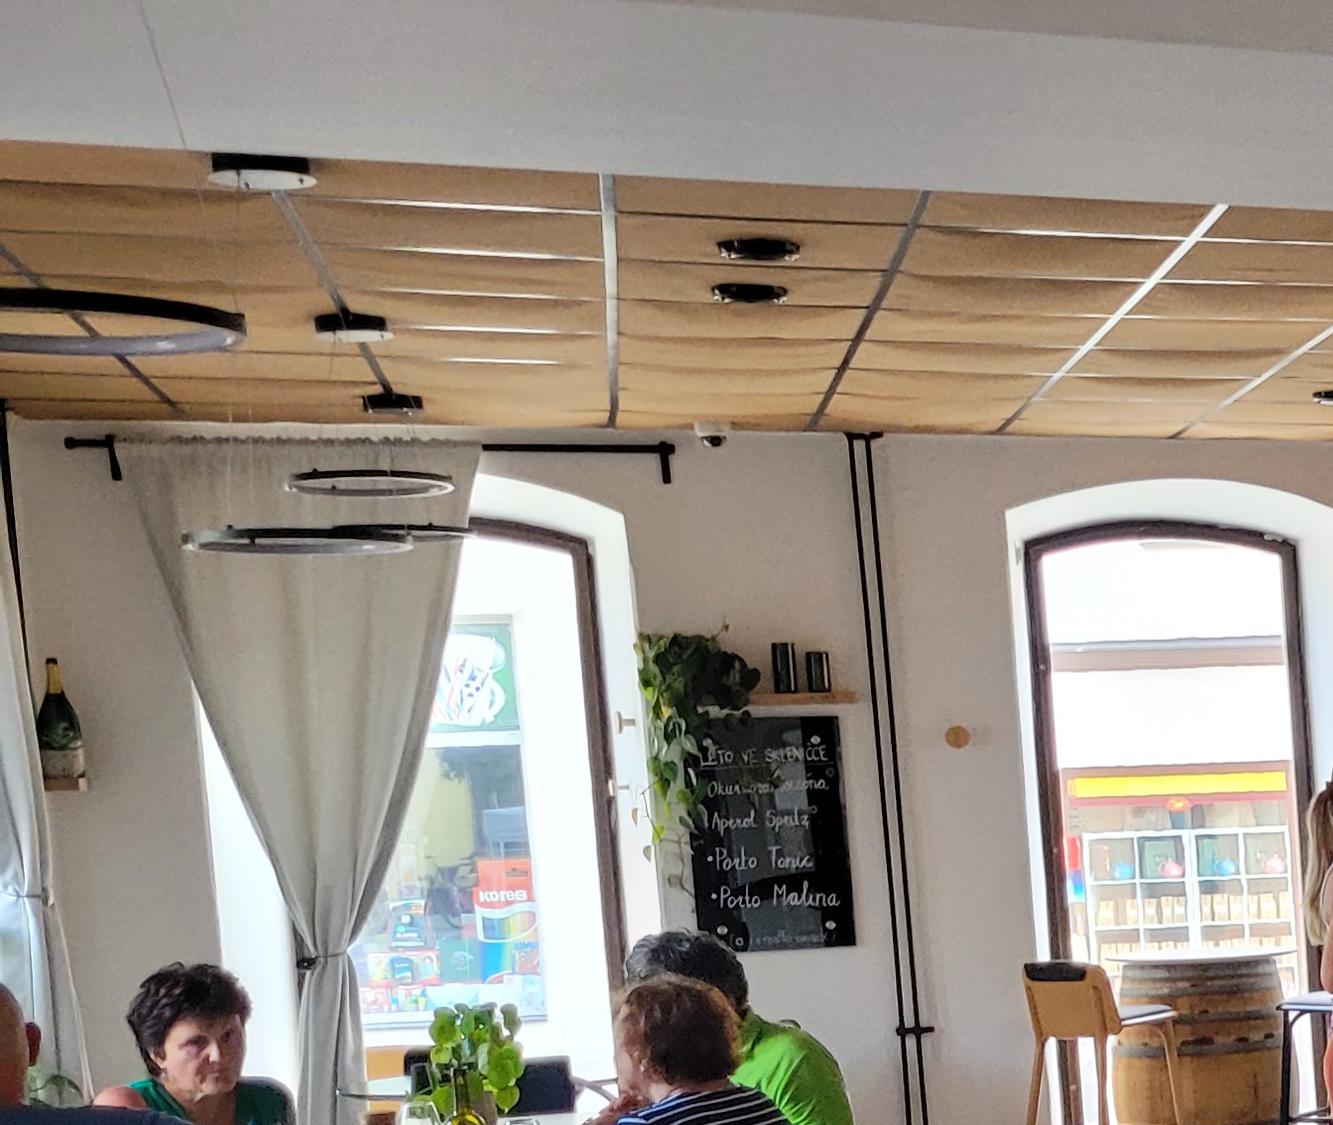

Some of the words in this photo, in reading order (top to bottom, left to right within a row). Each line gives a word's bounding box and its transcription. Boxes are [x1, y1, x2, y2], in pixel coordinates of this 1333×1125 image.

[712, 811, 758, 837] Aperol
[715, 846, 758, 871] Porto
[768, 846, 814, 869] Tonic
[720, 883, 761, 909] Porto
[774, 880, 841, 908] Malina
